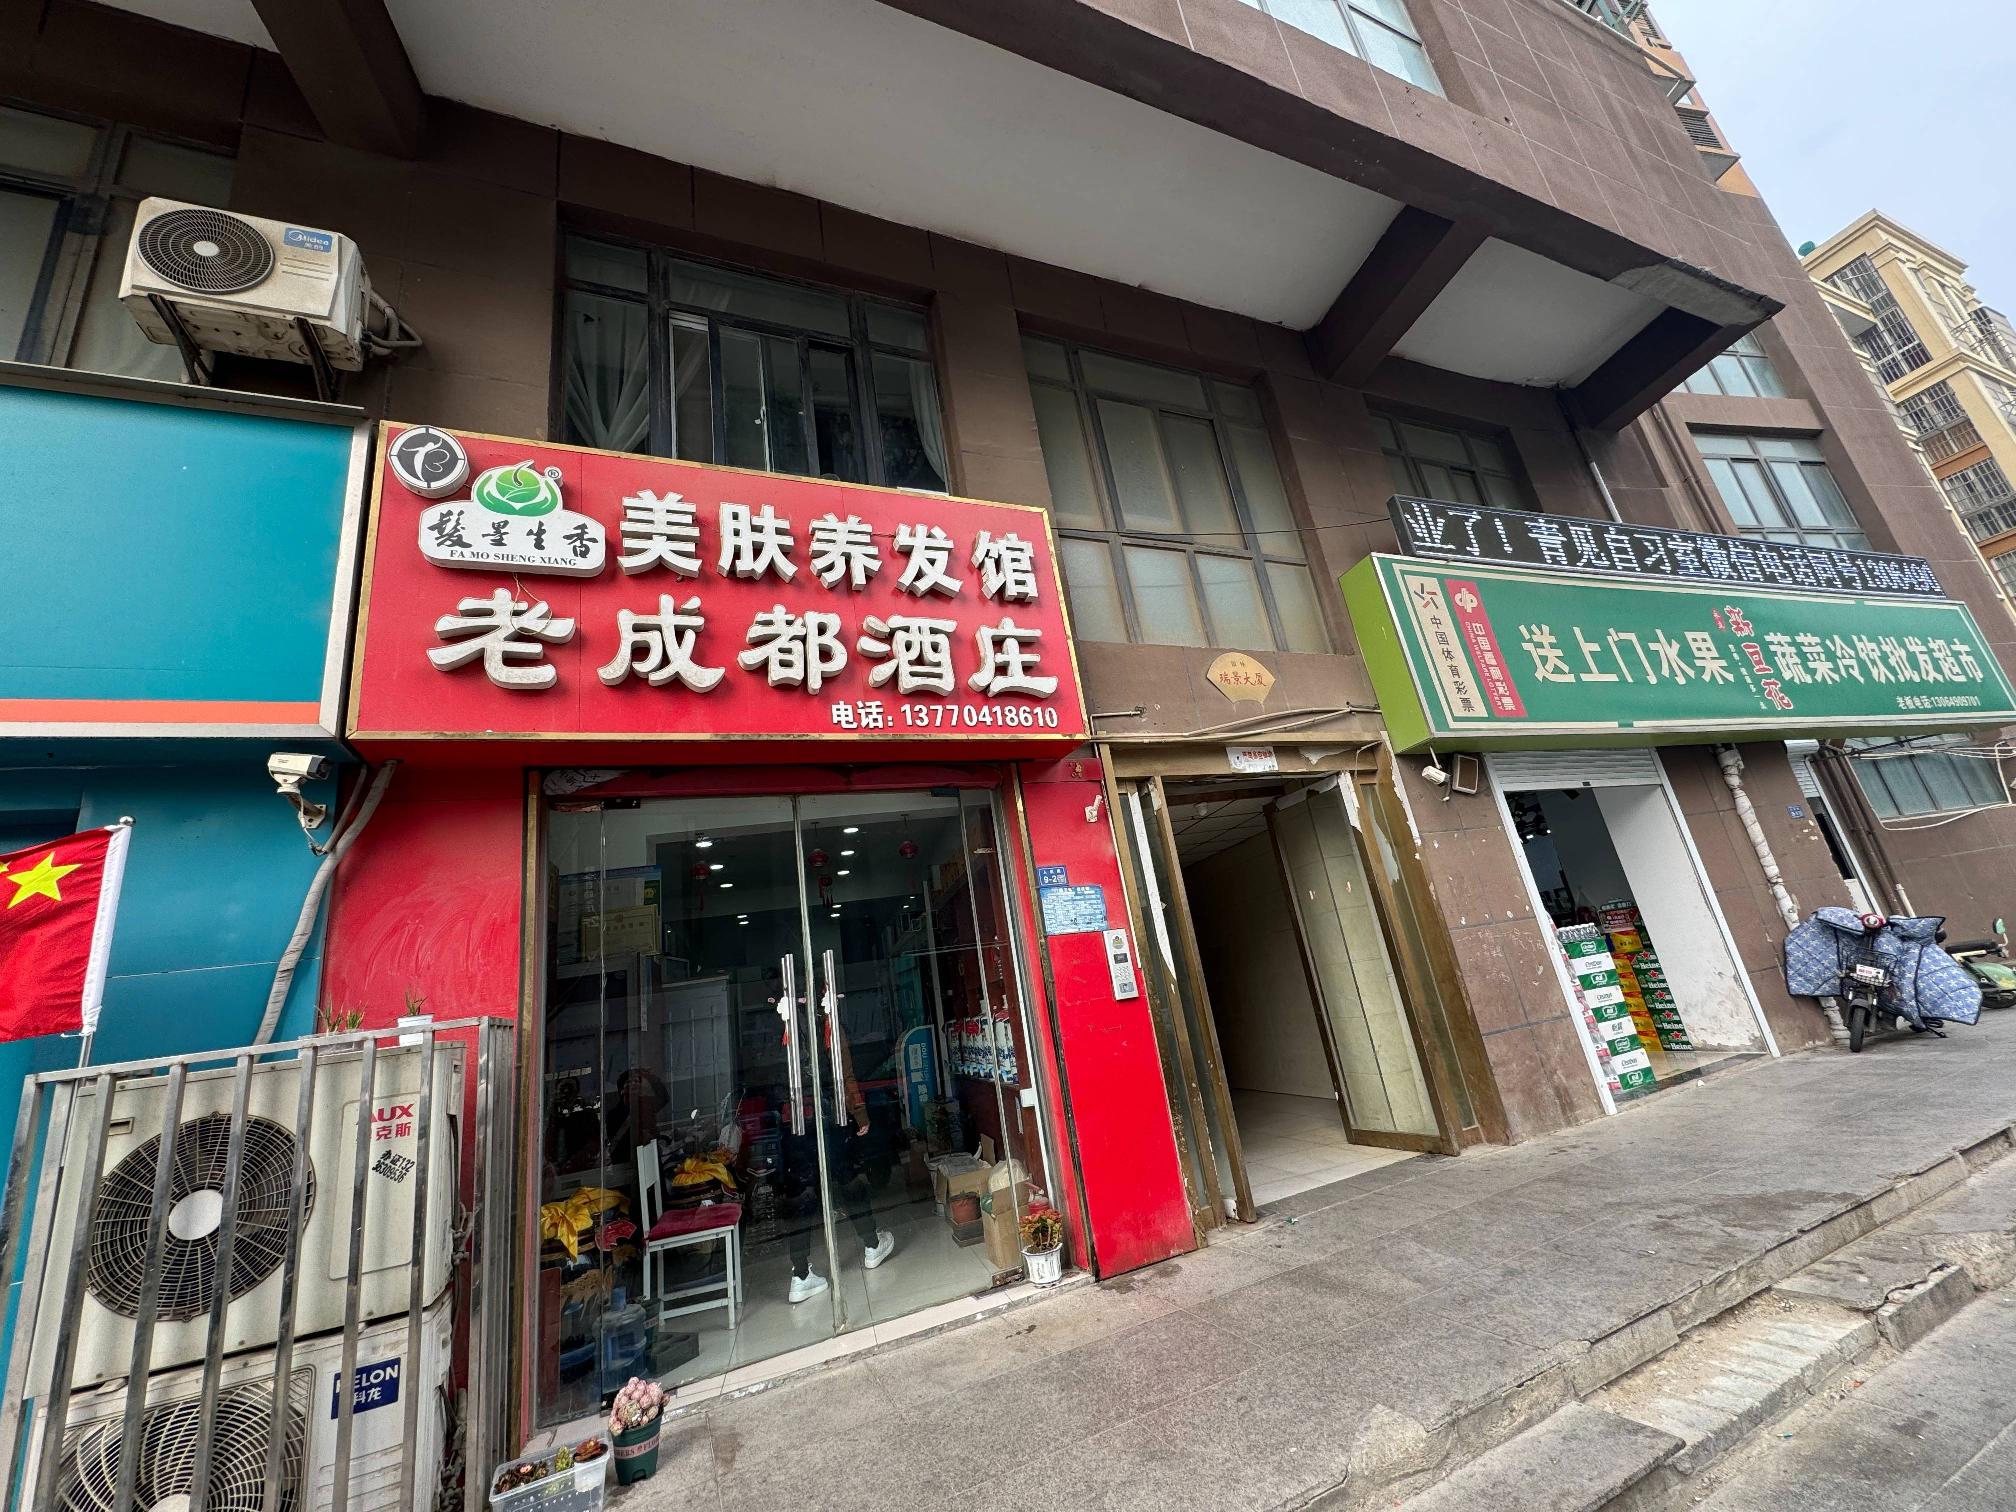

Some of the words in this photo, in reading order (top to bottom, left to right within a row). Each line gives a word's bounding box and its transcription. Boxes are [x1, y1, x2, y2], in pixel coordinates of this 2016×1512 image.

[450, 550, 465, 560] FA
[471, 551, 489, 560] MO
[494, 552, 536, 564] SHENG
[540, 556, 577, 567] XIANG
[617, 490, 1039, 601] 美肤养发馆
[427, 587, 1058, 698] 老成都酒庄
[1430, 614, 1476, 713] 中国体育彩票
[1518, 623, 1735, 685] 送上门水果
[1763, 632, 1984, 685] 蔬菜冷饮批发超市
[1219, 671, 1268, 687] 瑞景大厦
[369, 1121, 412, 1141] 克斯
